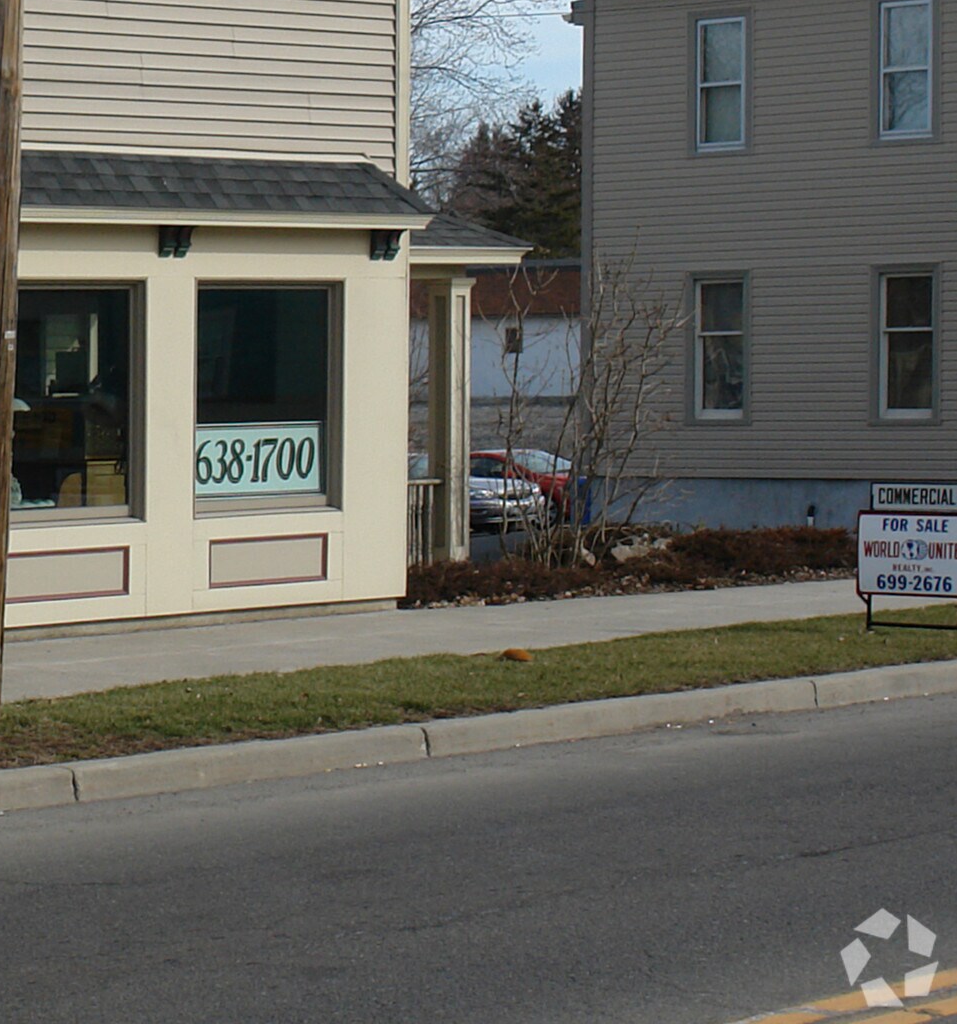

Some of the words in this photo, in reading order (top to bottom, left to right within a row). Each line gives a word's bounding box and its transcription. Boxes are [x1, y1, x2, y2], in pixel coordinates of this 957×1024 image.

[195, 436, 315, 485] 638-1700
[878, 487, 956, 506] COMMERCIAL
[882, 517, 908, 532] FOR
[916, 518, 949, 533] SALE
[863, 540, 900, 558] WORLD
[876, 574, 952, 592] 699-2676
